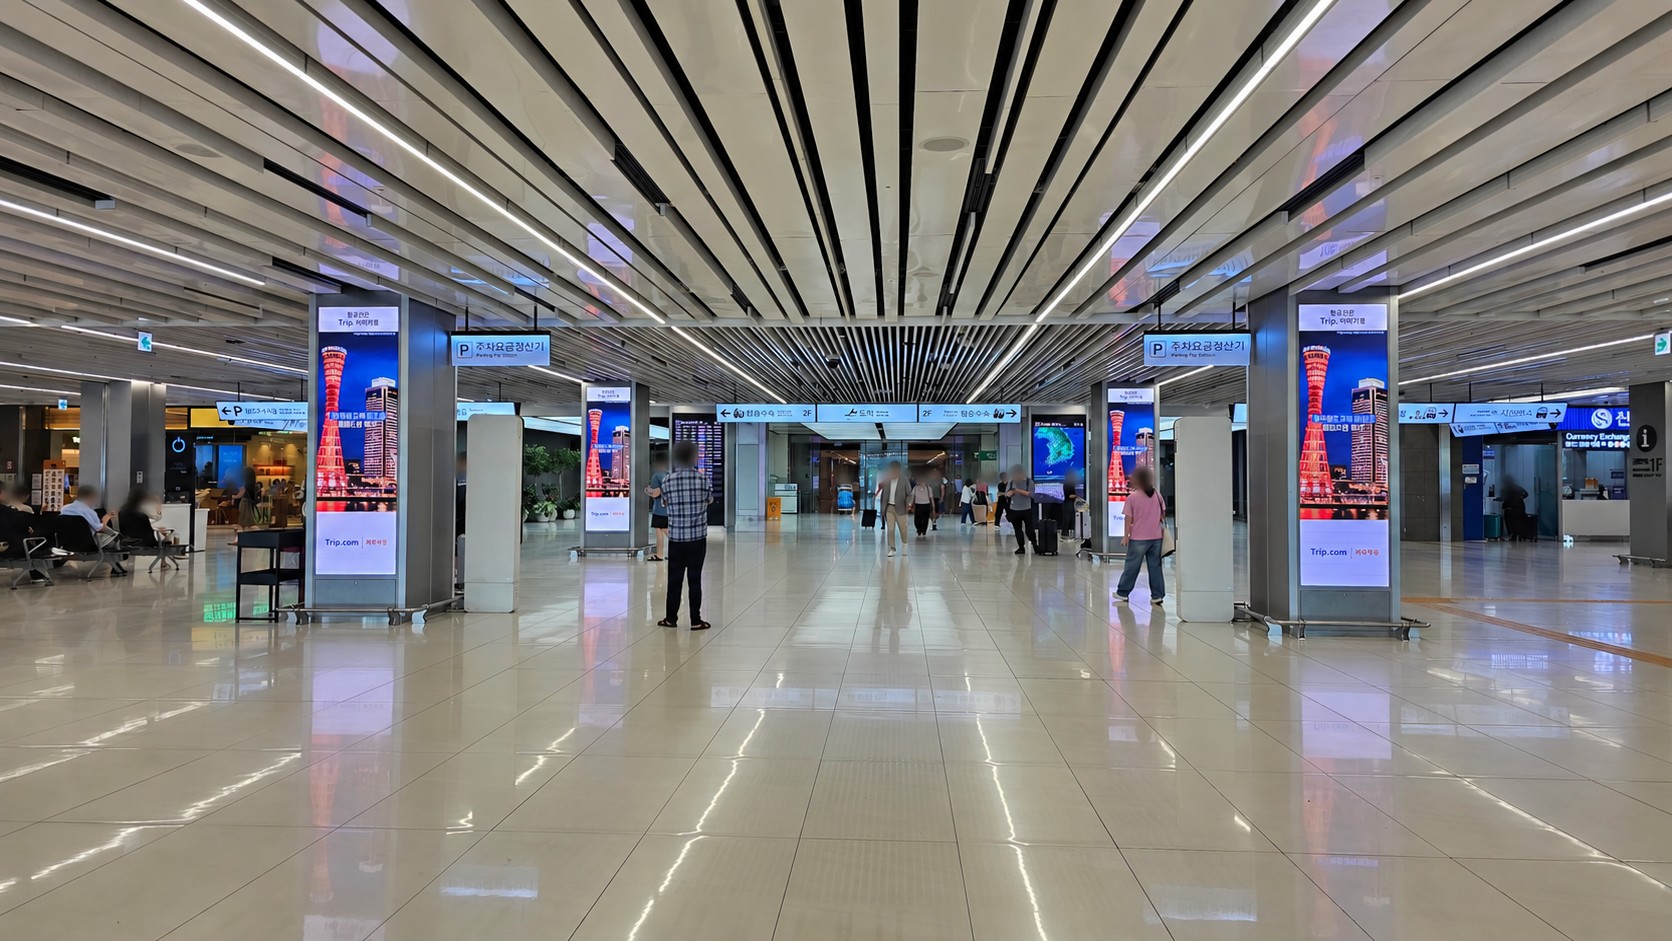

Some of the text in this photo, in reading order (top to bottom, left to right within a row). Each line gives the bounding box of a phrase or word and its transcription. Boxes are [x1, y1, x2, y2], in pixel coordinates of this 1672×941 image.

[802, 409, 812, 417] 2F
[1649, 457, 1663, 472] 1F
[325, 538, 359, 547] Trip.com
[1310, 548, 1347, 557] Trip.com
